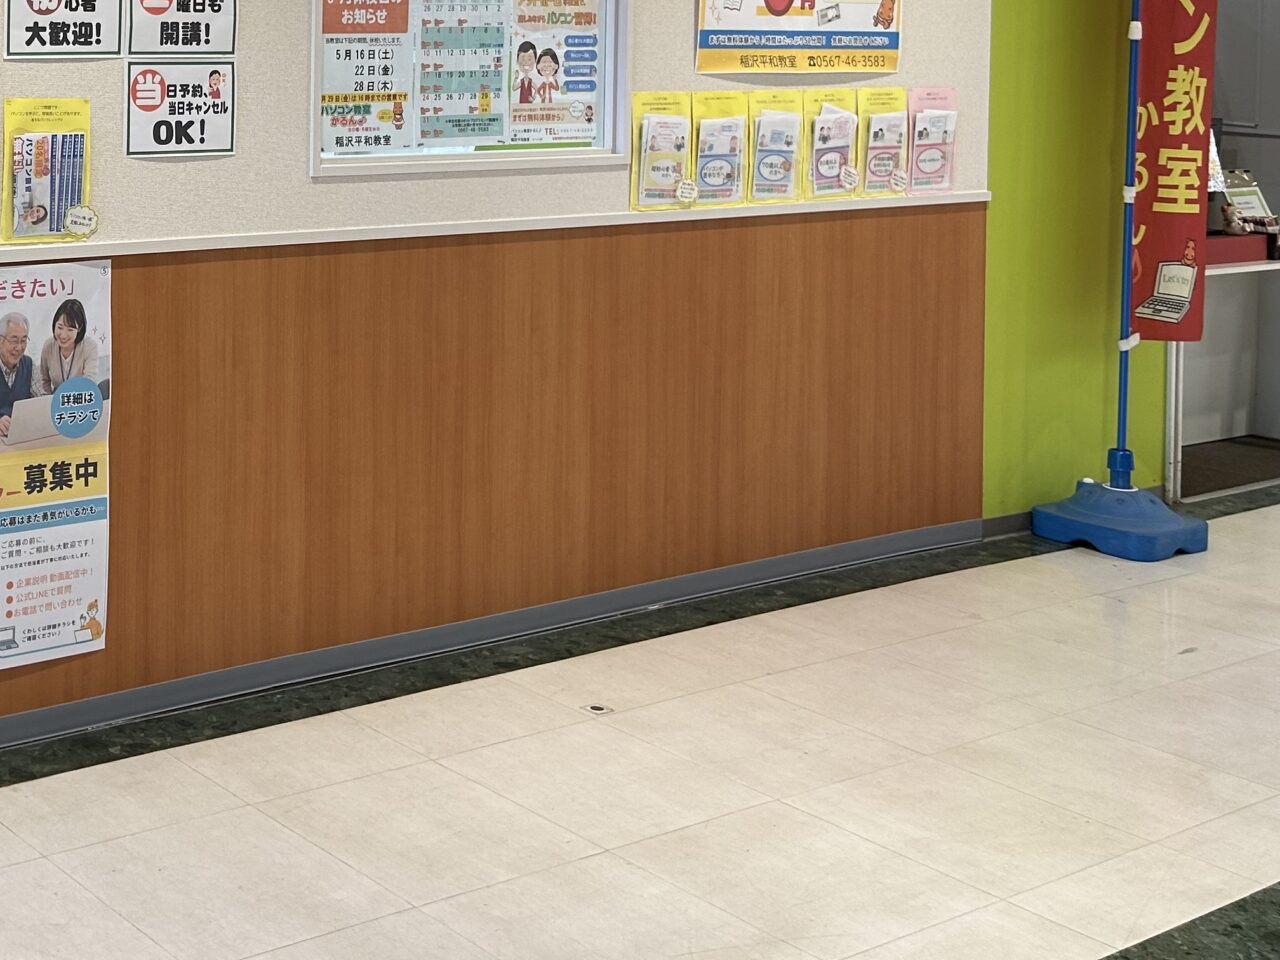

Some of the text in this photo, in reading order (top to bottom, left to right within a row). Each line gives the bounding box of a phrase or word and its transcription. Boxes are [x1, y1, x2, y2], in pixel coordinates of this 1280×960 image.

[341, 9, 387, 24] お知らせ
[25, 21, 101, 46] 大歓迎!
[160, 21, 210, 46] 開講!
[740, 55, 886, 68] 稲沢平和教室 0567-46-3583
[168, 101, 228, 115] 当日キャンセル
[152, 119, 206, 146] OK!
[335, 135, 392, 147] 稲沢平和教室
[60, 392, 94, 407] 詳細は
[55, 409, 99, 426] チラシで
[24, 458, 98, 496] 募集中
[16, 585, 72, 603] 公式LINEで質問
